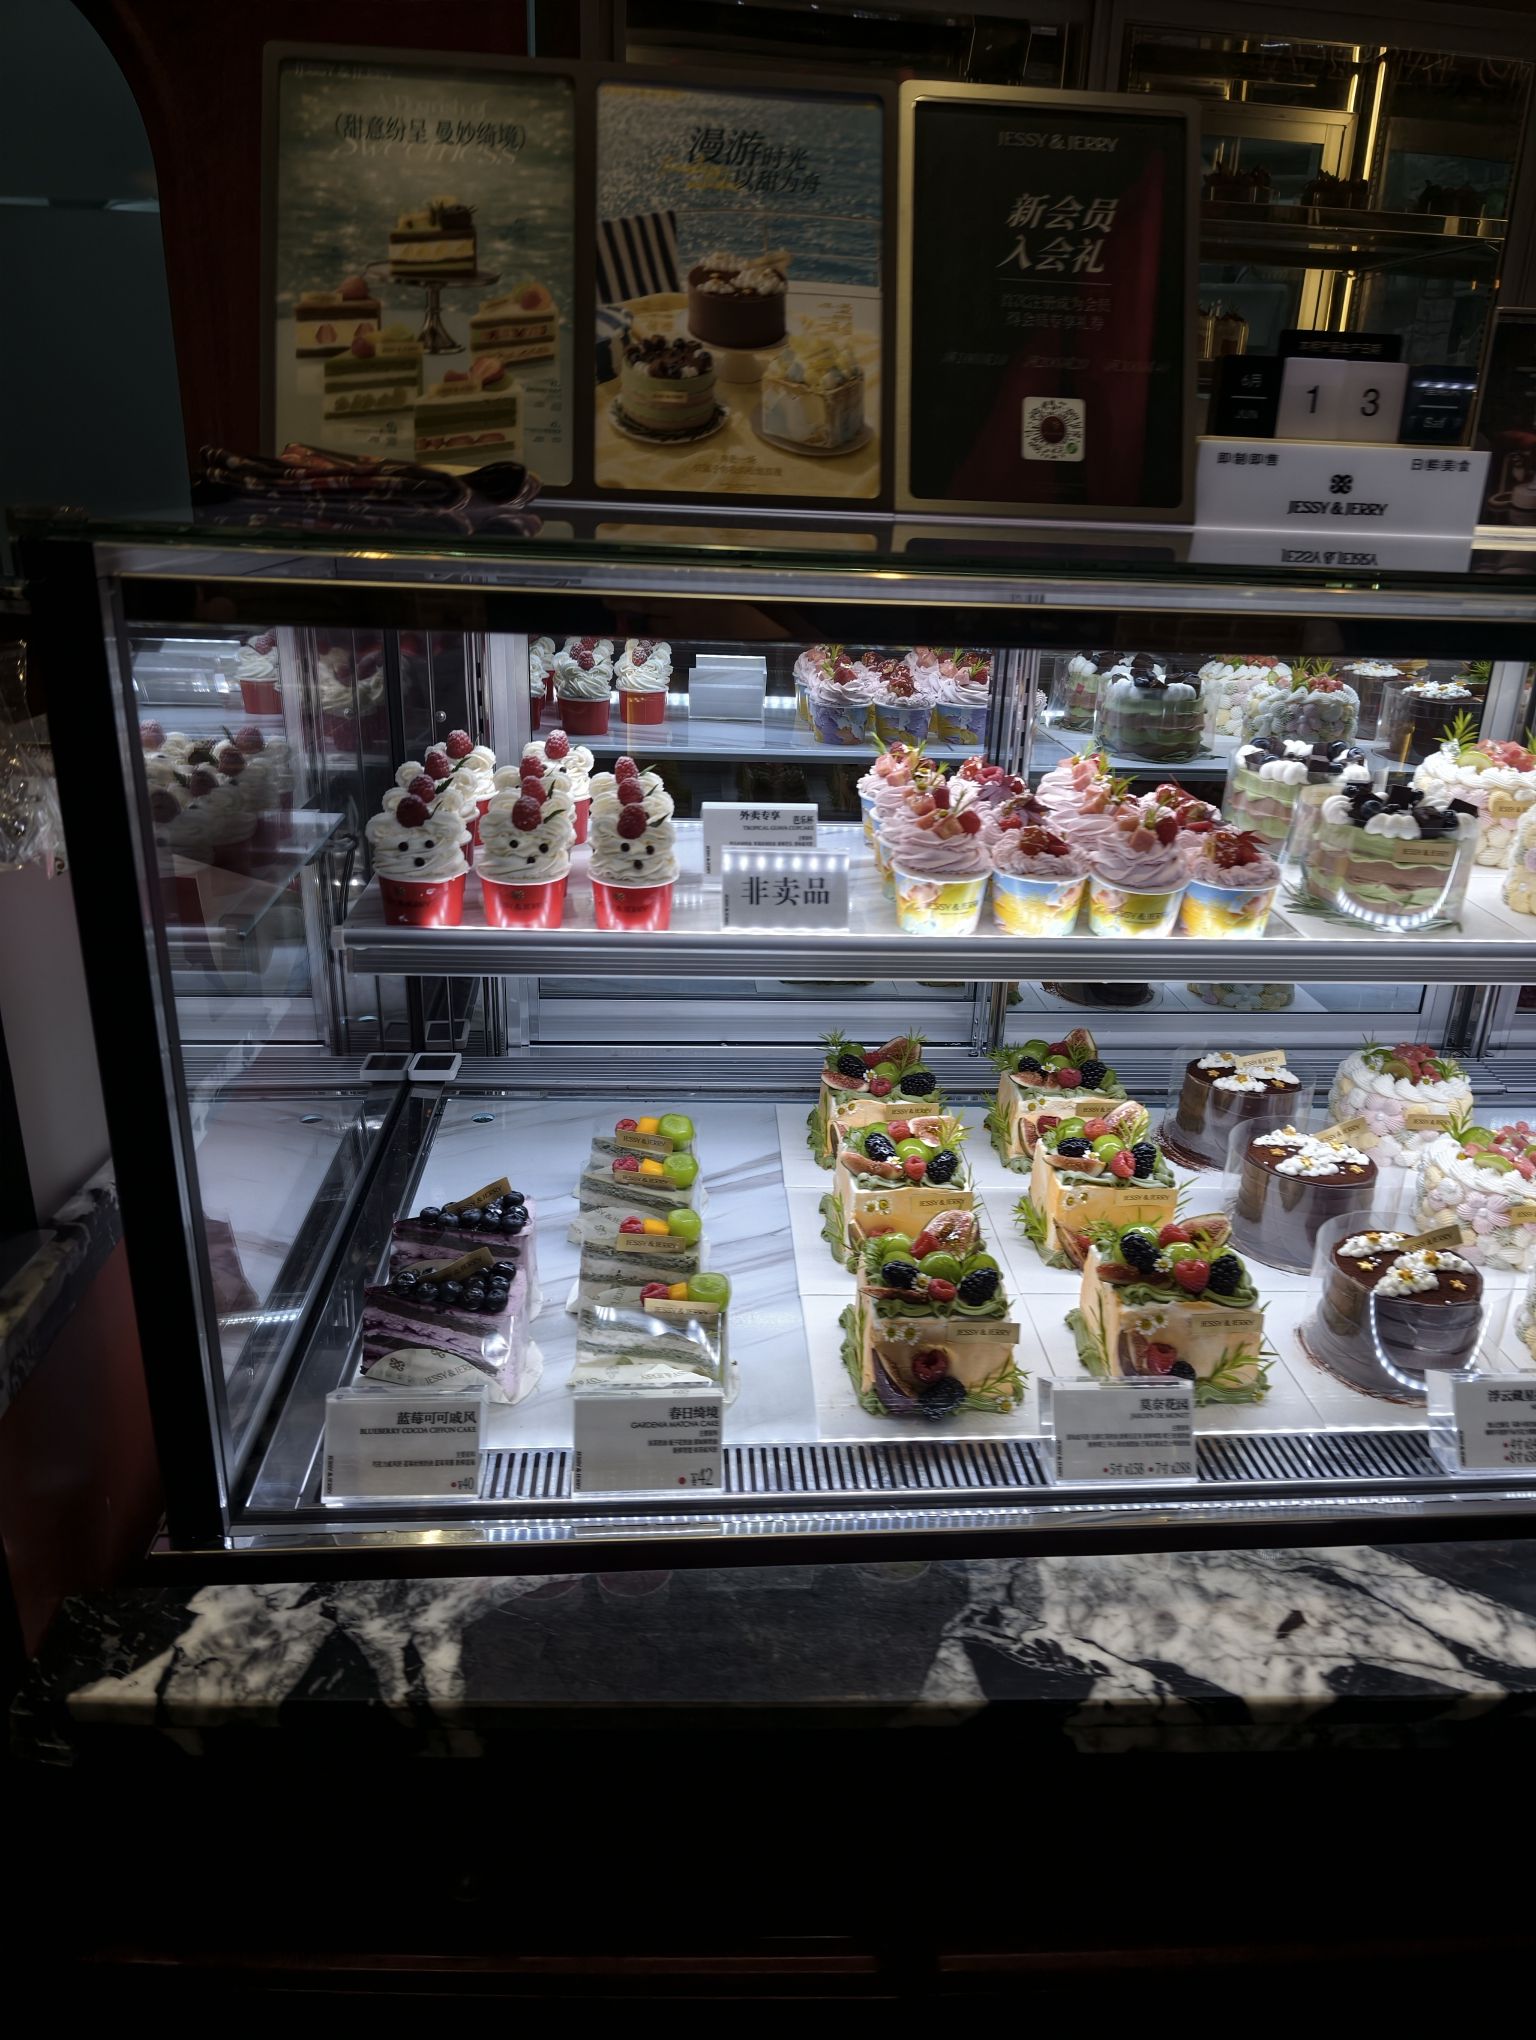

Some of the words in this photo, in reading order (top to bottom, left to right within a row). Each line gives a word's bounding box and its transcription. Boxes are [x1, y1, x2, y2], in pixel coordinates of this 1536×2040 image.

[688, 126, 809, 170] 漫游时光
[998, 131, 1048, 148] JESSY
[1048, 134, 1066, 149] &
[1067, 135, 1120, 153] JERRY
[1005, 192, 1120, 233] 新会员
[994, 233, 1106, 273] 入会礼
[1240, 373, 1264, 388] 6月
[1306, 385, 1320, 414] 1
[1360, 388, 1380, 416] 3
[1217, 452, 1280, 466] 即制即售
[1287, 501, 1331, 515] JESSY
[1331, 503, 1344, 515] &
[1344, 503, 1388, 516] JERRY
[740, 811, 781, 821] 外卖专享
[741, 876, 831, 907] 非卖品
[424, 1370, 447, 1385] JESSY
[1139, 1398, 1189, 1410] 莫奈花园
[397, 1411, 477, 1425] 蓝莓可可戚风
[669, 1406, 720, 1420] 春日绮境
[457, 1476, 475, 1490] ¥40
[690, 1467, 714, 1486] ¥42
